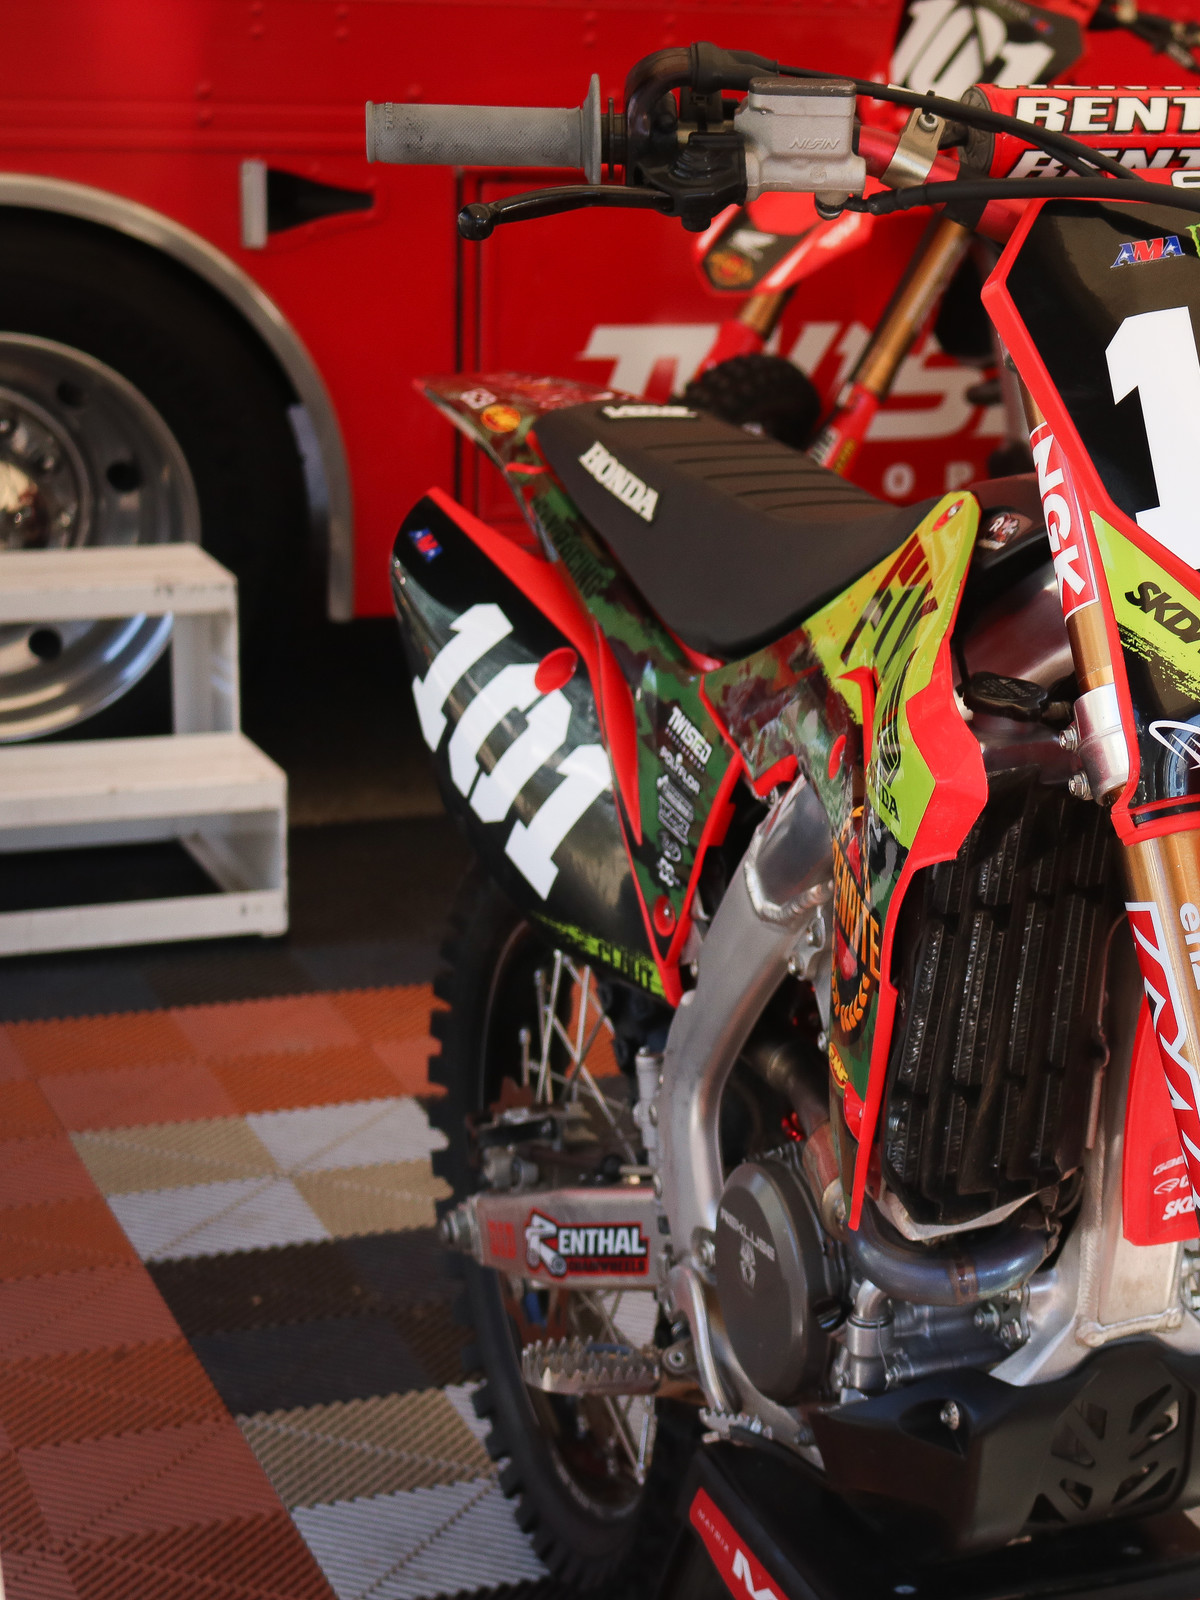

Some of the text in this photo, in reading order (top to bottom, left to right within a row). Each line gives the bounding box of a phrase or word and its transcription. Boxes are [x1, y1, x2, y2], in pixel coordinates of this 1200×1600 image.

[790, 138, 840, 150] NISSIN
[1110, 235, 1186, 268] AMA
[578, 440, 659, 522] HONDA
[1032, 434, 1087, 608] NGK
[411, 602, 613, 901] 101
[667, 705, 713, 765] TWISTED
